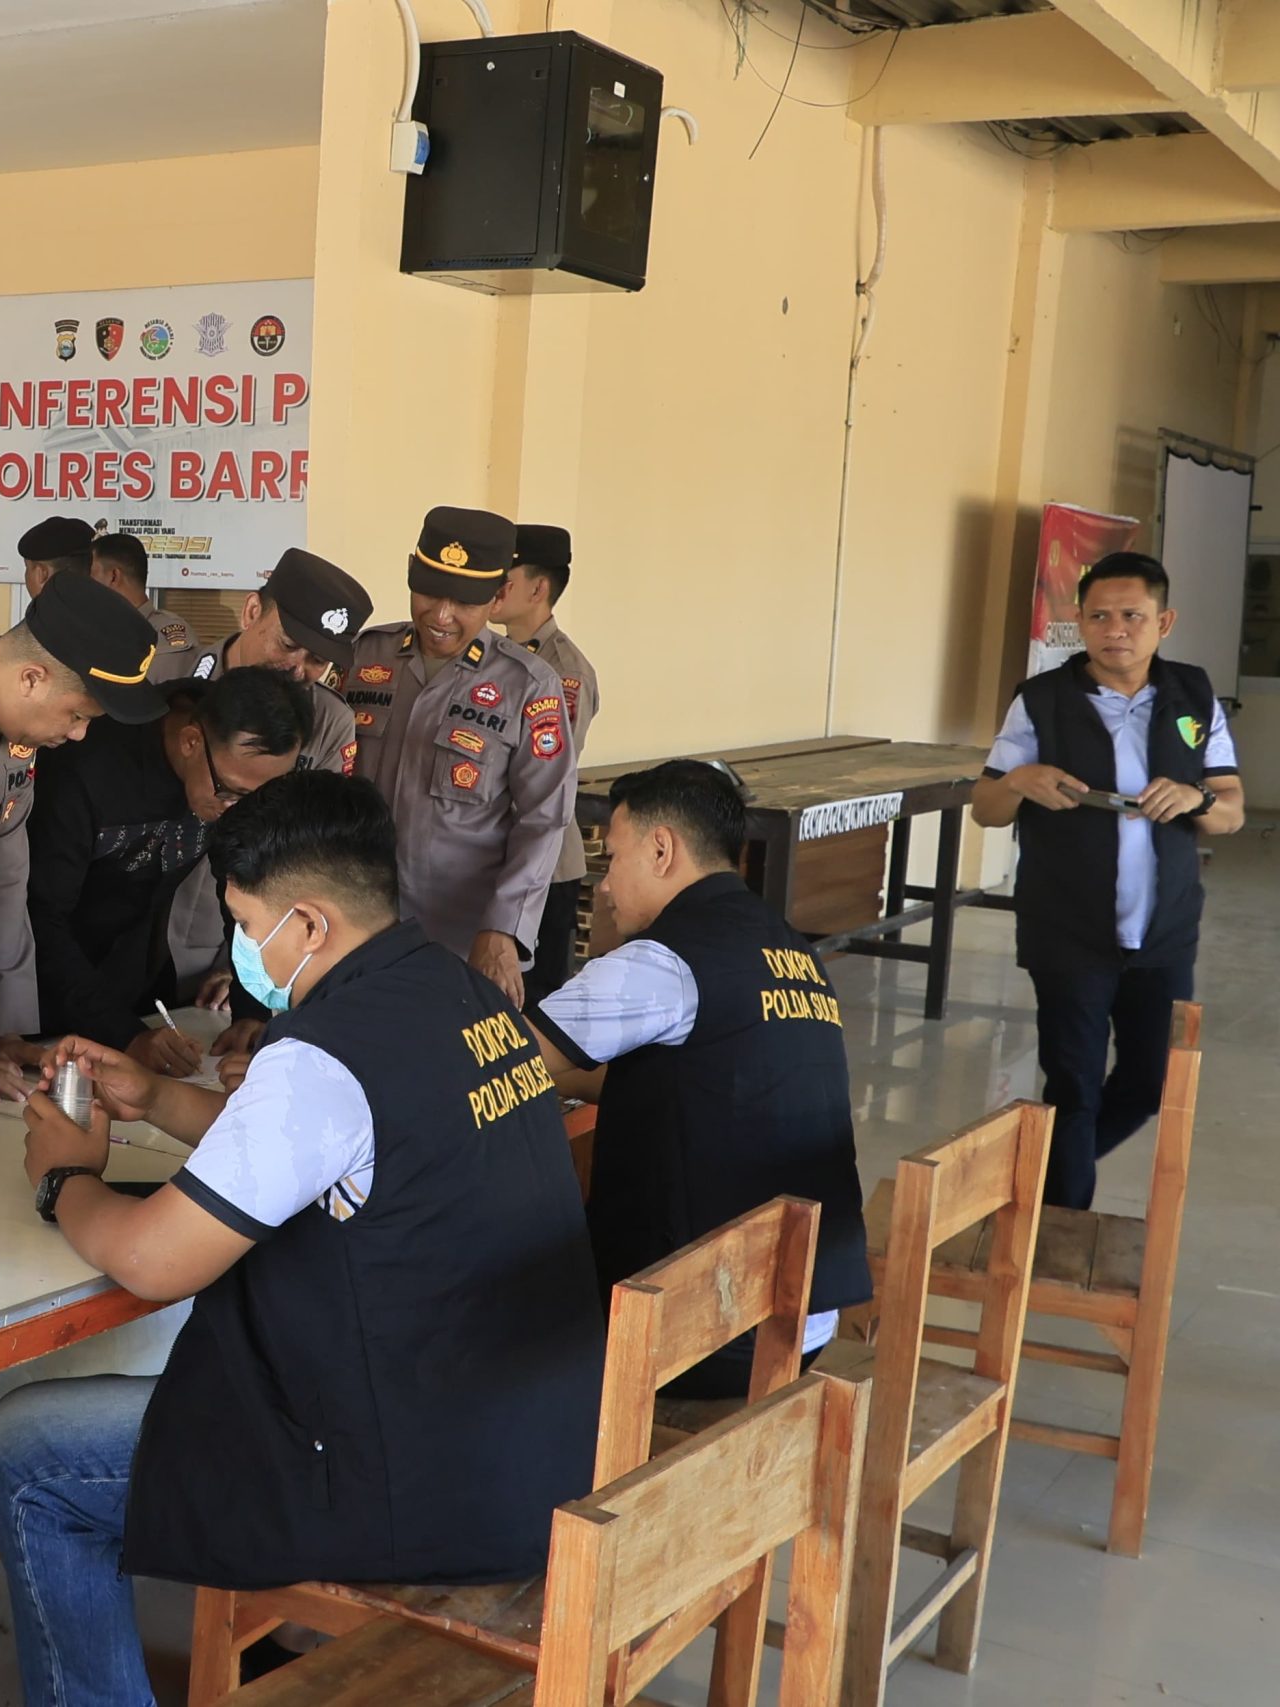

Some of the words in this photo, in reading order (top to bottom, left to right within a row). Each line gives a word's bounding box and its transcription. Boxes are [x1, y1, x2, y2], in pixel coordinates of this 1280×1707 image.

[271, 373, 308, 425] P
[169, 450, 308, 502] BARR
[448, 704, 507, 733] POLRI
[761, 948, 827, 987] DOKPOL
[760, 989, 814, 1021] POLDA
[462, 1011, 528, 1068] DOKPOL
[468, 1072, 520, 1129] POLDA
[511, 1055, 555, 1101] SULSE
